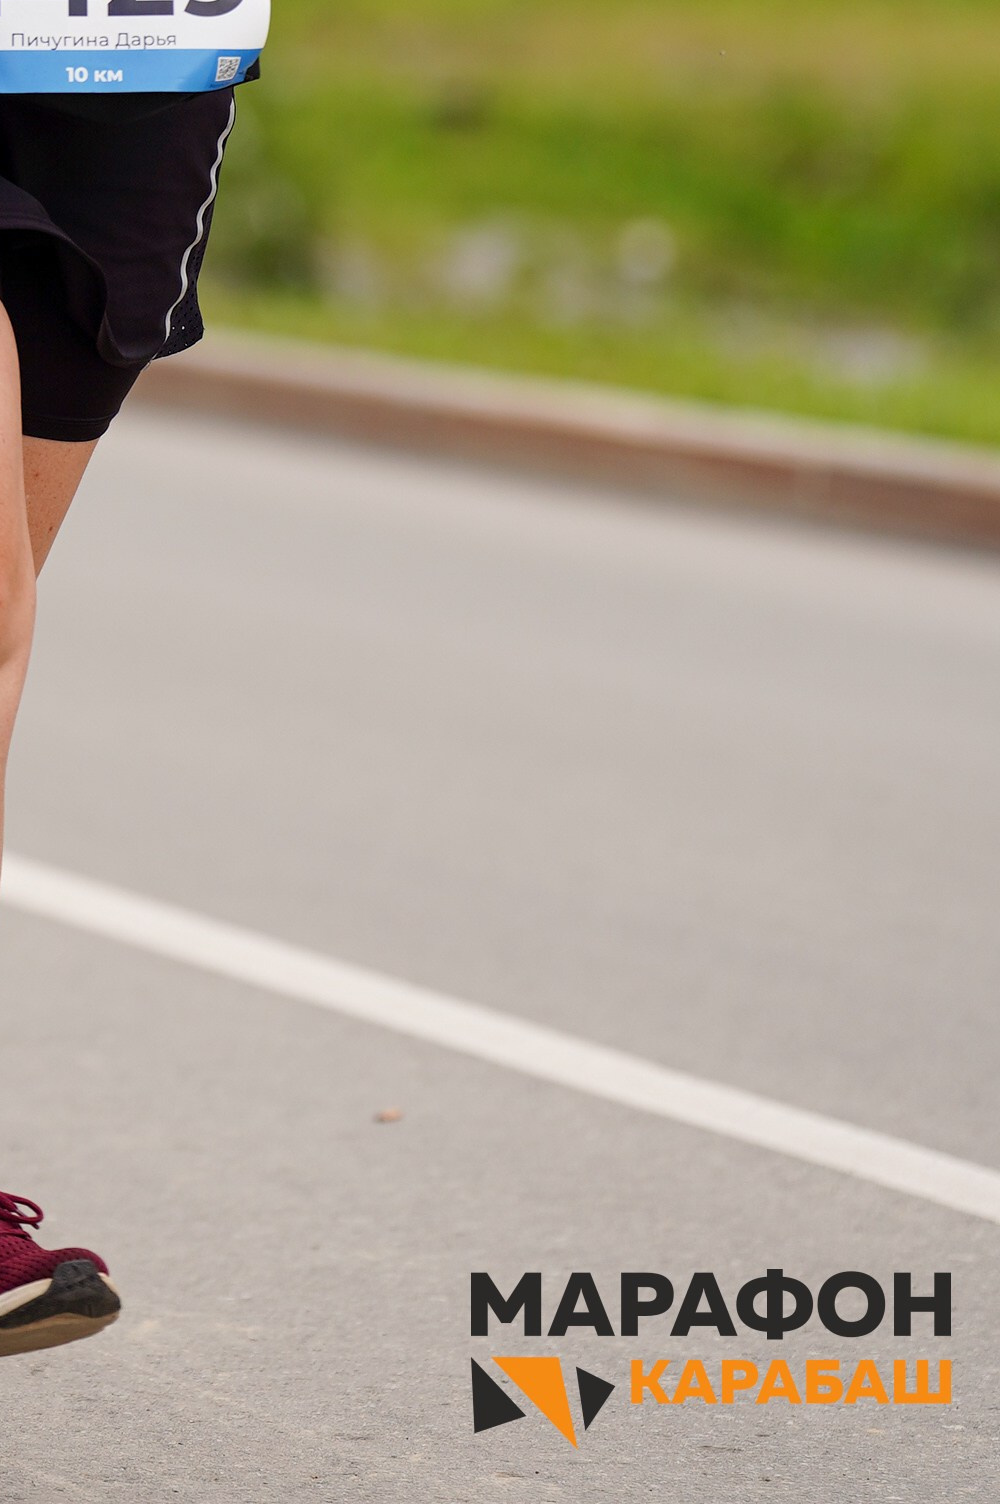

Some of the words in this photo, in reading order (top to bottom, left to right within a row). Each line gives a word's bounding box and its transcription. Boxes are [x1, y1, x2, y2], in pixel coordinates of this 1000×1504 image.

[11, 32, 109, 51] Пичугина
[115, 32, 177, 50] Дарья
[65, 66, 89, 83] 10
[94, 69, 123, 83] км
